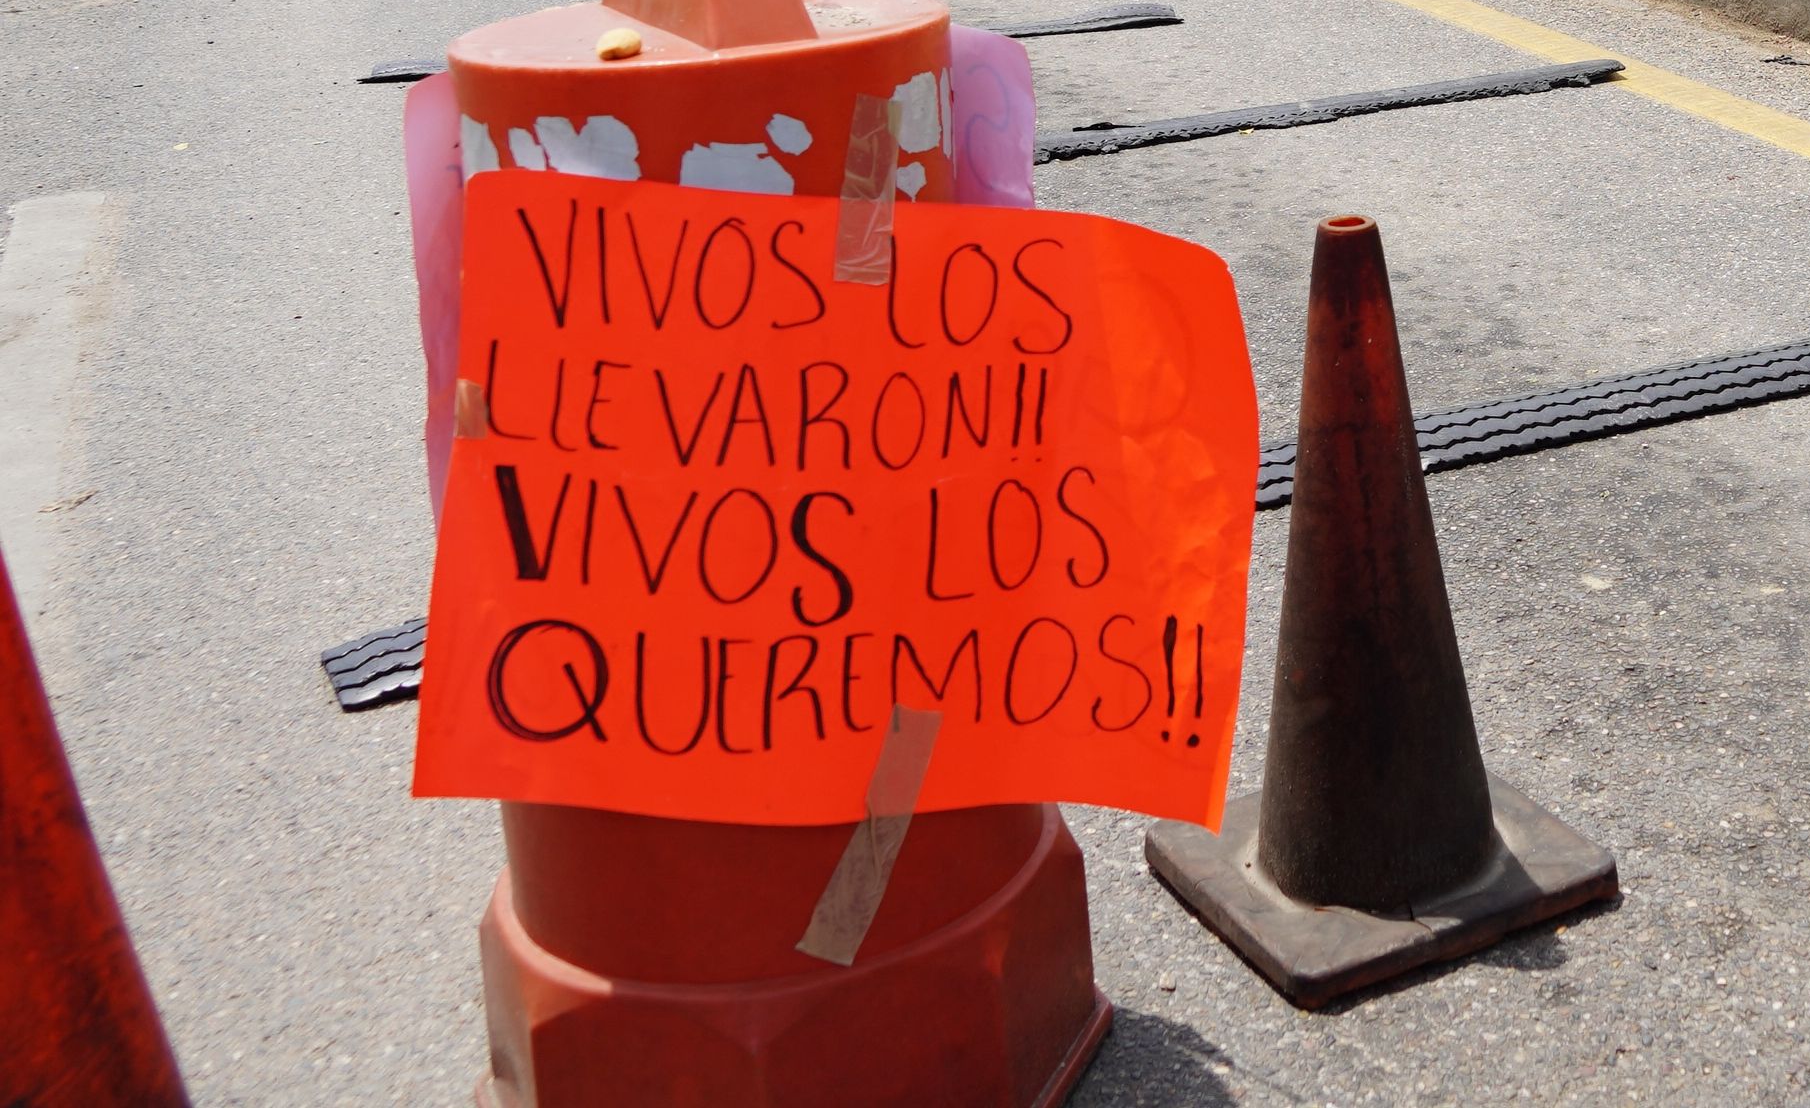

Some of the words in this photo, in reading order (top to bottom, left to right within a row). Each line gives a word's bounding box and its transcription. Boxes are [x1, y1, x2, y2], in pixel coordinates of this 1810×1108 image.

[516, 200, 826, 330] VIVOS
[887, 234, 1074, 355] LOS
[484, 339, 1048, 472] LLEVARON!!
[495, 464, 855, 629] VIVOS
[925, 466, 1110, 602] LOS
[486, 614, 1205, 756] QUEREMOS!!
